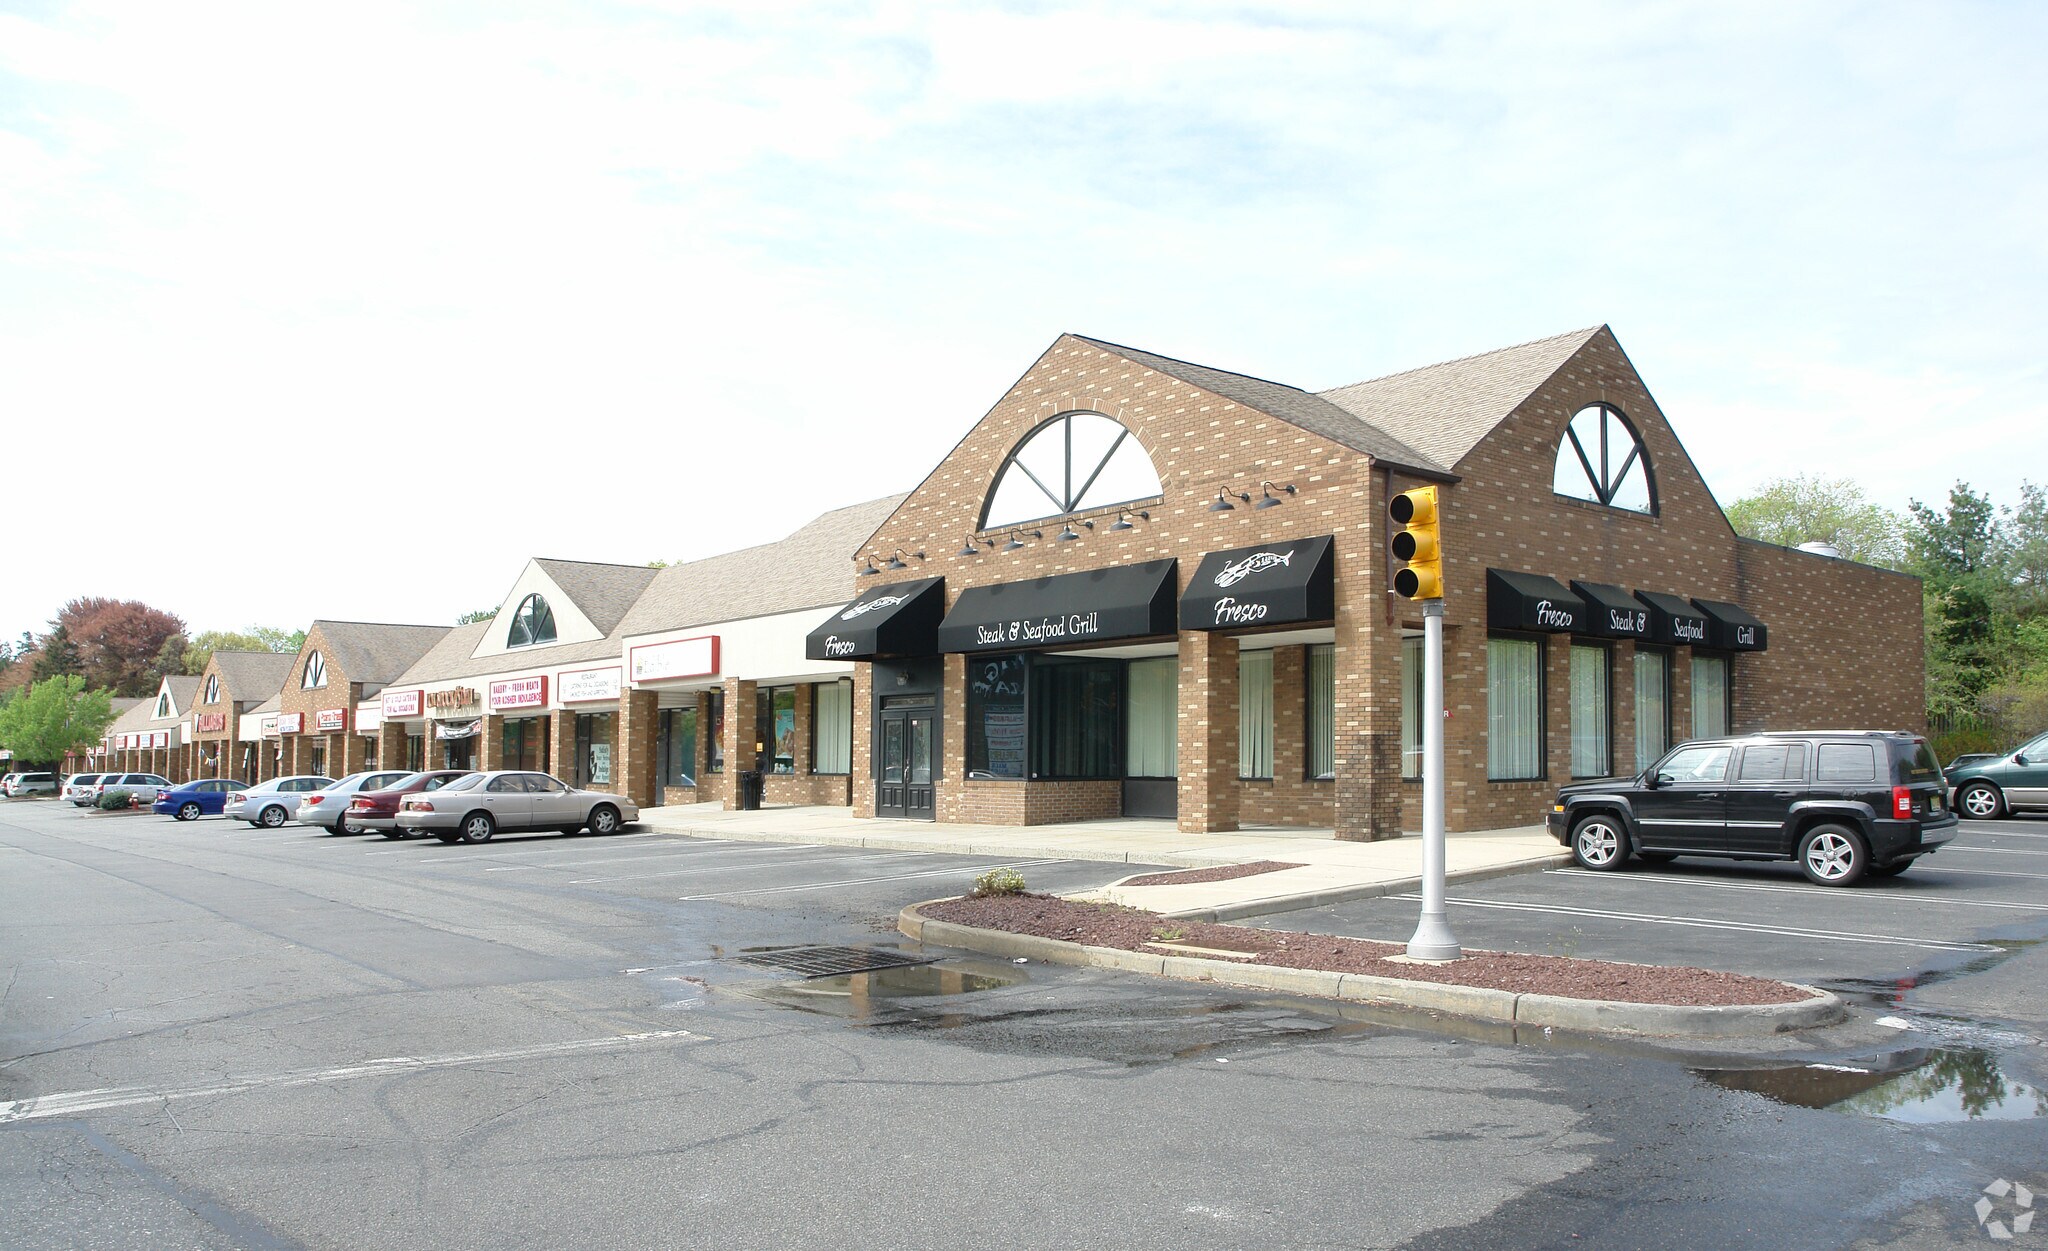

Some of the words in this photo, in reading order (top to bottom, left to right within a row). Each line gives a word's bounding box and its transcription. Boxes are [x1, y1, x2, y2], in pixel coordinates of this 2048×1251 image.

[1214, 596, 1268, 625] Fresco
[1537, 600, 1573, 627] Fresco
[1610, 609, 1634, 631] Steak
[1636, 612, 1646, 632] &
[977, 622, 1006, 644] Steak
[1008, 621, 1021, 641] &
[1022, 618, 1065, 641] Seafood
[1069, 613, 1098, 634] Grill
[1674, 617, 1704, 641] Seafood
[1737, 626, 1754, 645] Grill
[824, 635, 855, 656] Fresco
